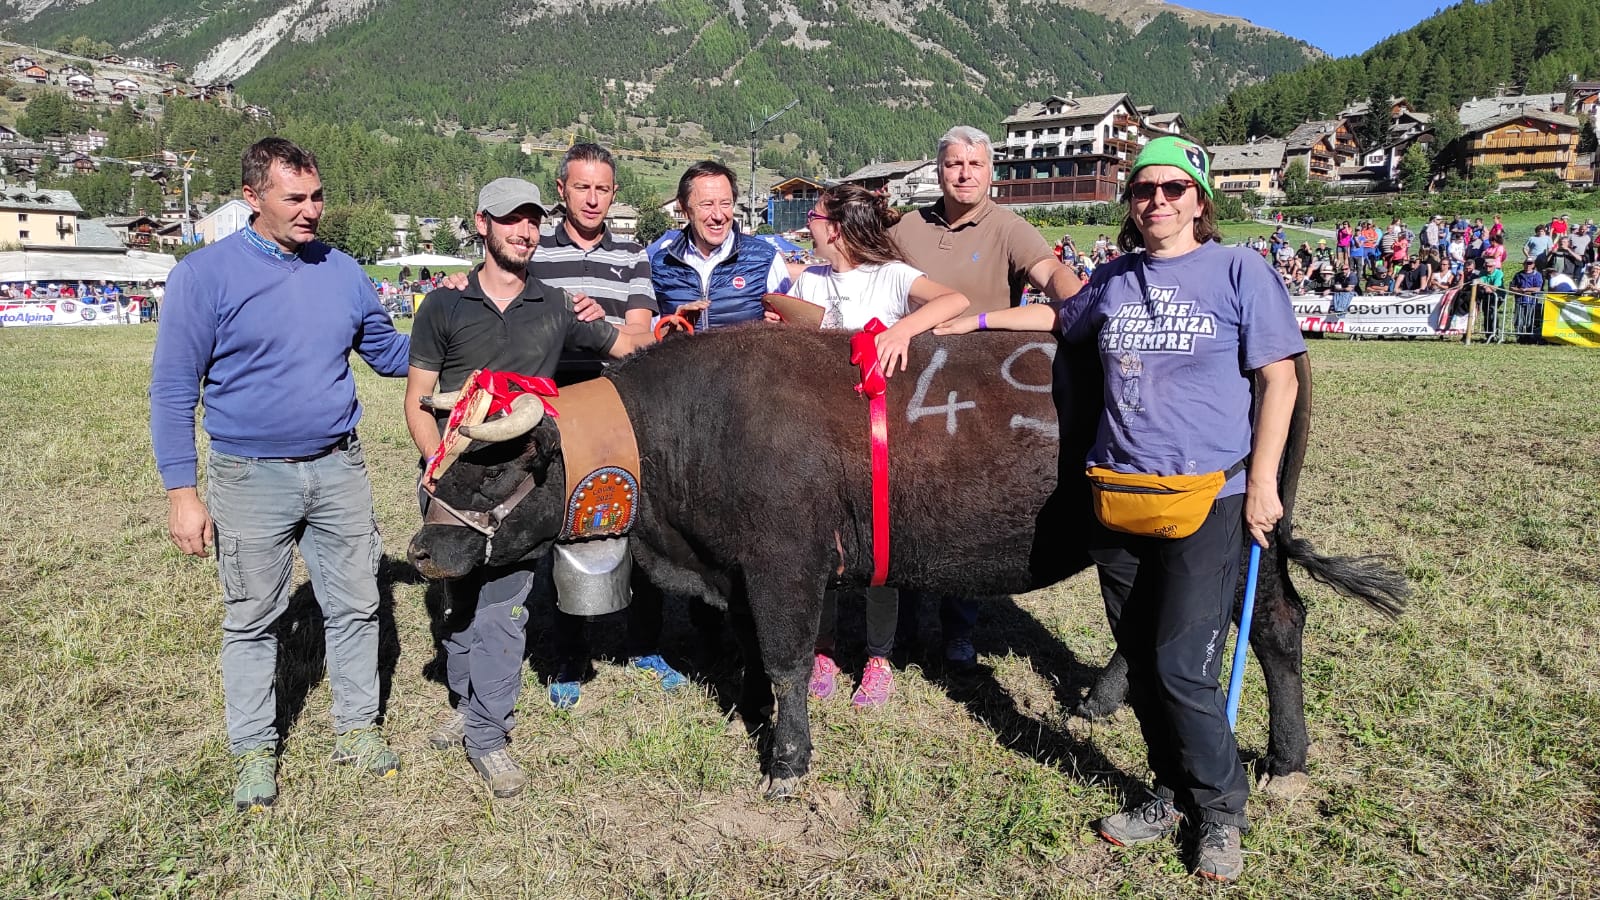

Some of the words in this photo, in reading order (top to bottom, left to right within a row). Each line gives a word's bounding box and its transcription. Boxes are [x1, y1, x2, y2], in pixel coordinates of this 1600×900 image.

[1118, 302, 1190, 318] MOLARE
[1329, 304, 1431, 315] PODUTTORI
[1123, 317, 1213, 333] SPERANZA
[1381, 325, 1428, 334] D'AOSTA
[1123, 333, 1192, 350] SEMPRE
